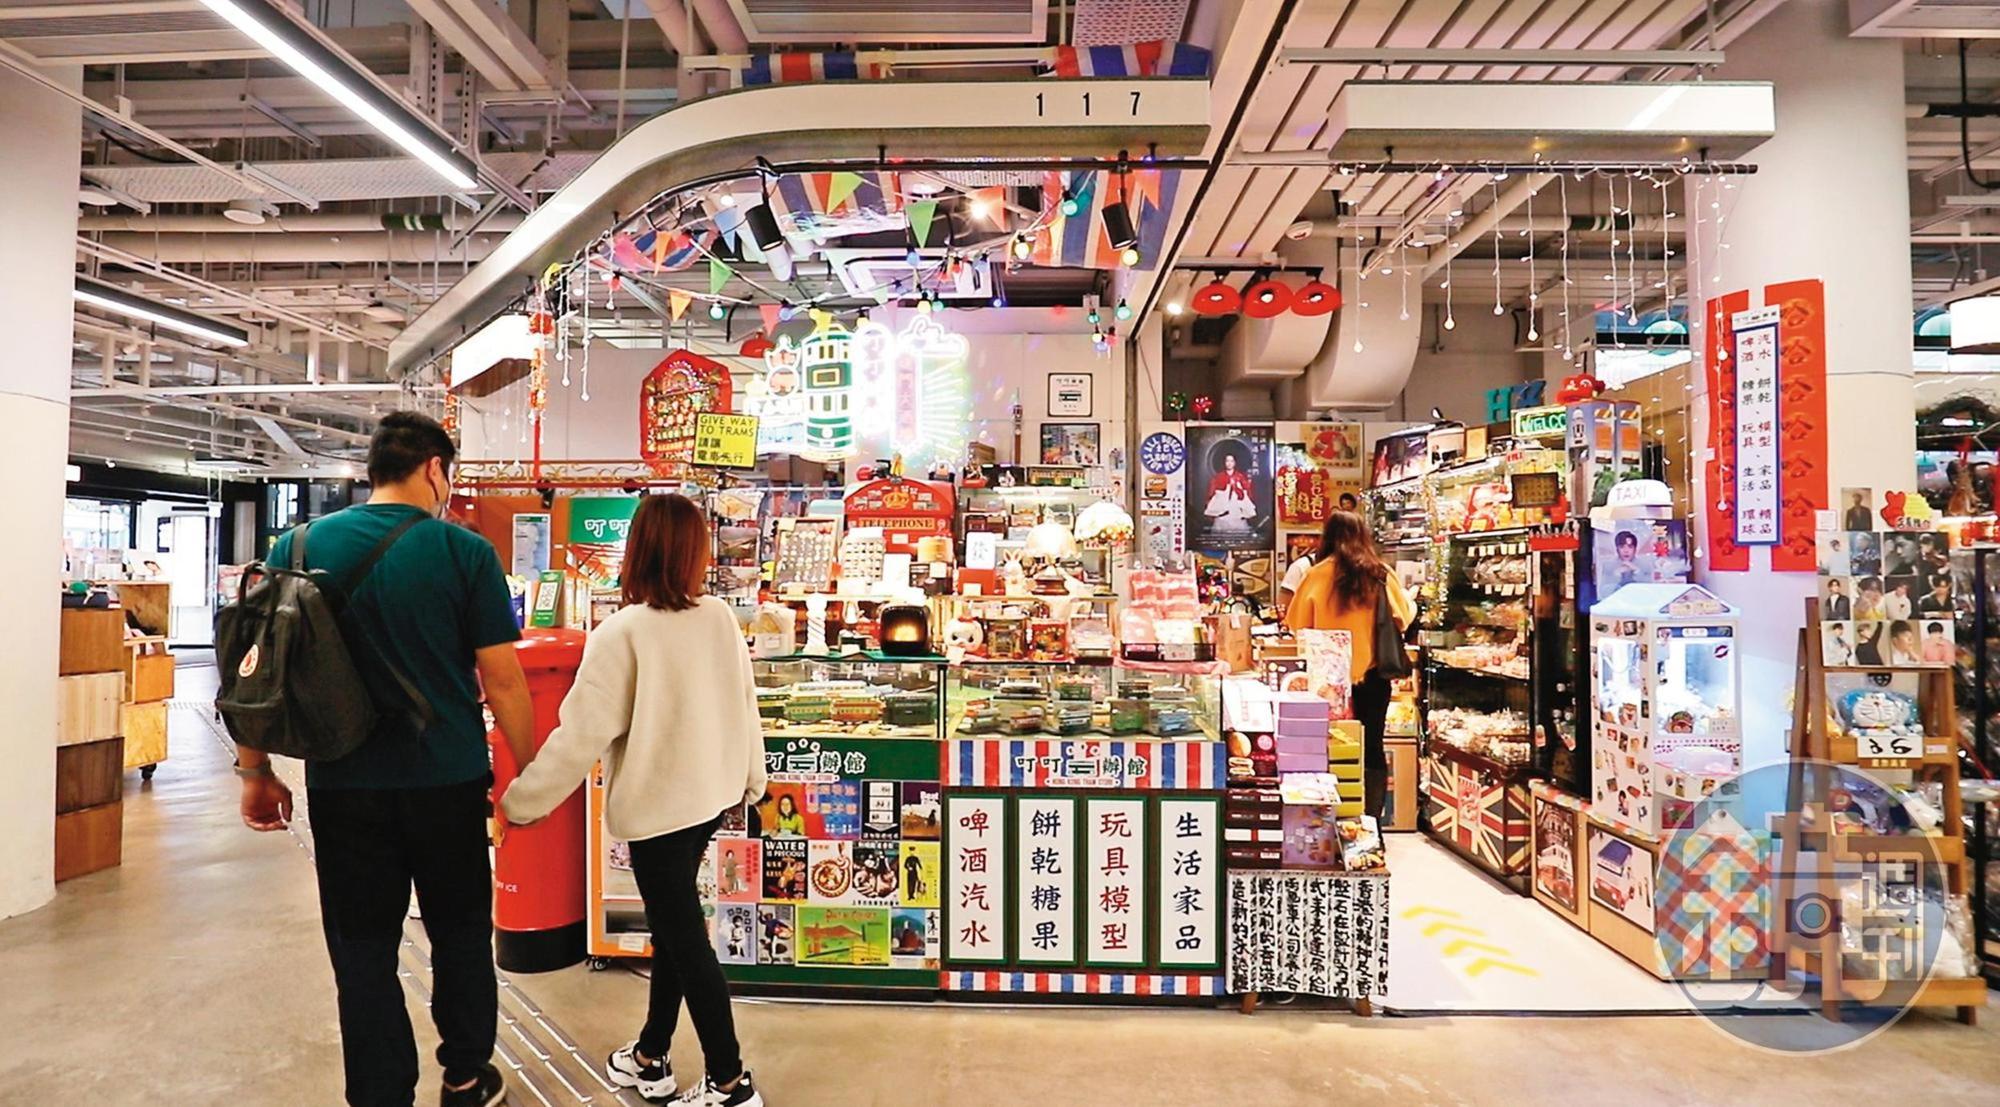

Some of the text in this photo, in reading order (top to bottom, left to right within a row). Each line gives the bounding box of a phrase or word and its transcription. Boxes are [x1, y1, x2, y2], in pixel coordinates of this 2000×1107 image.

[700, 415, 754, 426] GIVE WAY
[700, 424, 754, 437] TO TRAMS
[1616, 485, 1648, 501] TAXI
[862, 519, 934, 528] TELEPHONE
[765, 841, 806, 851] WATER
[959, 808, 991, 948] 啤酒汽水
[1030, 809, 1062, 951] 餅乾糖果
[1099, 811, 1132, 951] 玩具模型
[1172, 811, 1204, 951] 生活家品
